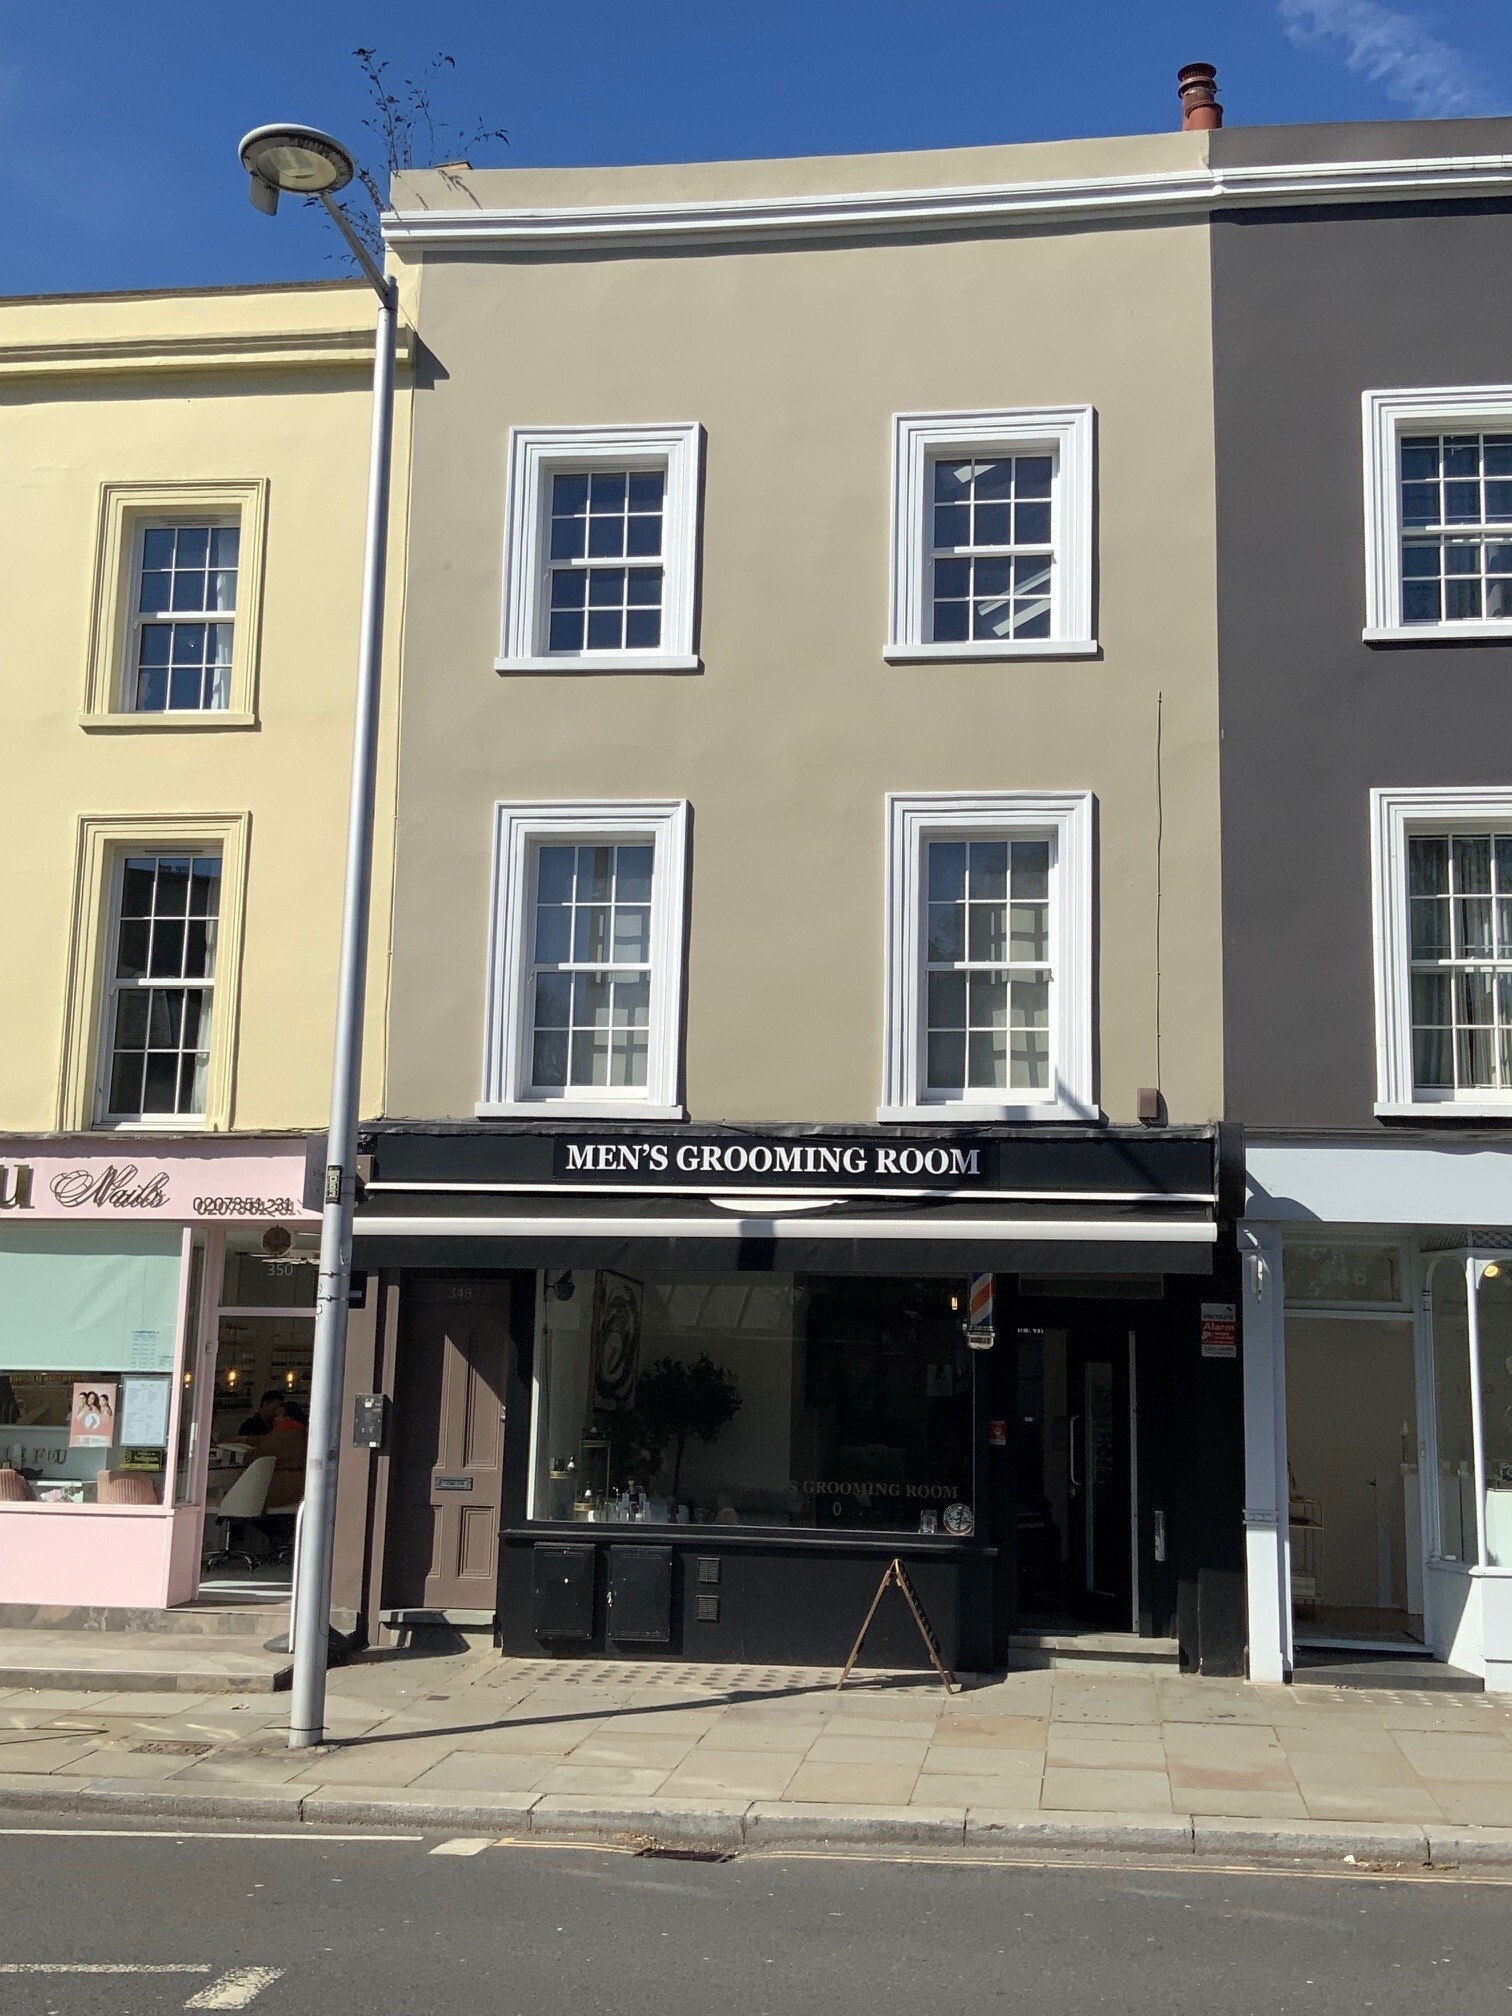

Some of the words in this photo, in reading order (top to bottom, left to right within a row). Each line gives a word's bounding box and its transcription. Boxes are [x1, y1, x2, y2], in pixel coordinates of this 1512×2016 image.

[566, 1144, 668, 1171] MEN'S
[676, 1145, 868, 1174] GROOMING
[875, 1148, 981, 1175] ROOM
[50, 1164, 173, 1208] Nails
[266, 1263, 293, 1276] 350
[1202, 1322, 1235, 1331] Alarm
[803, 1481, 901, 1497] GROOMING
[905, 1485, 958, 1499] ROOM
